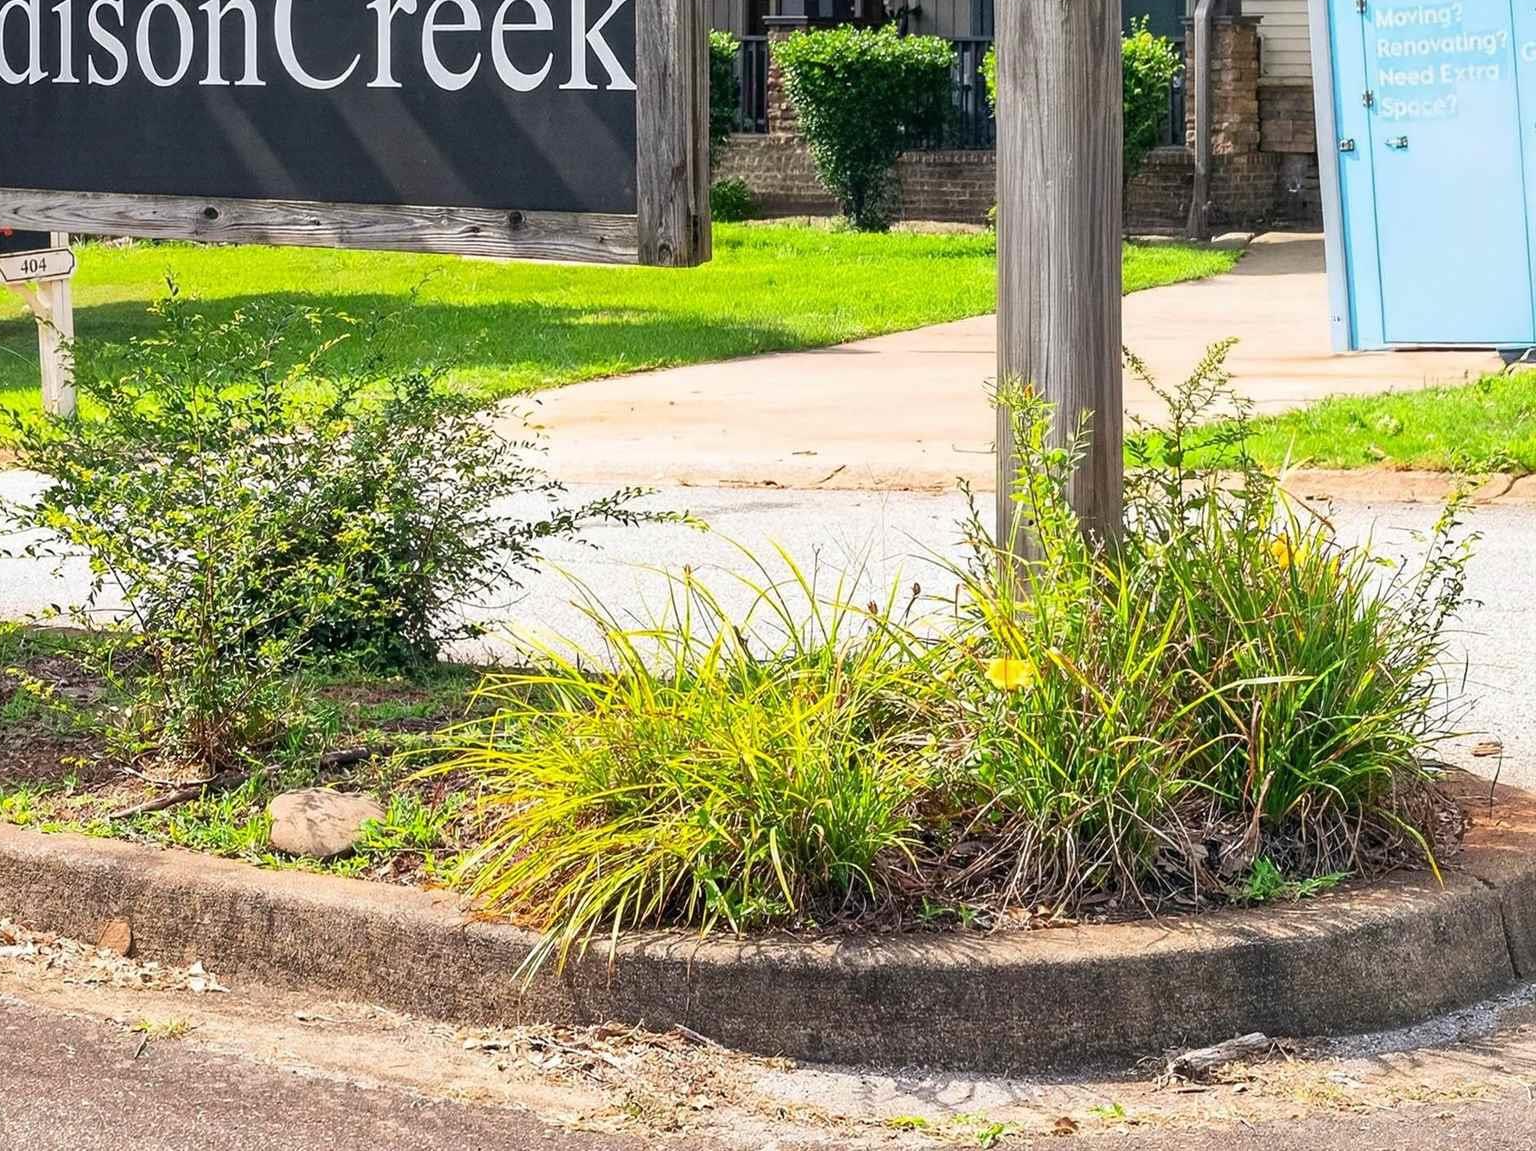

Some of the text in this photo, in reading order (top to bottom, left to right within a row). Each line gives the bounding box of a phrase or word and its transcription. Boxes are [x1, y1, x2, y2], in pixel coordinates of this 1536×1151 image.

[1376, 1, 1464, 28] Moving?
[1376, 31, 1508, 57] Renovating?
[1378, 63, 1500, 86] Need Extra
[1380, 94, 1457, 120] Space?
[20, 257, 48, 275] 404
